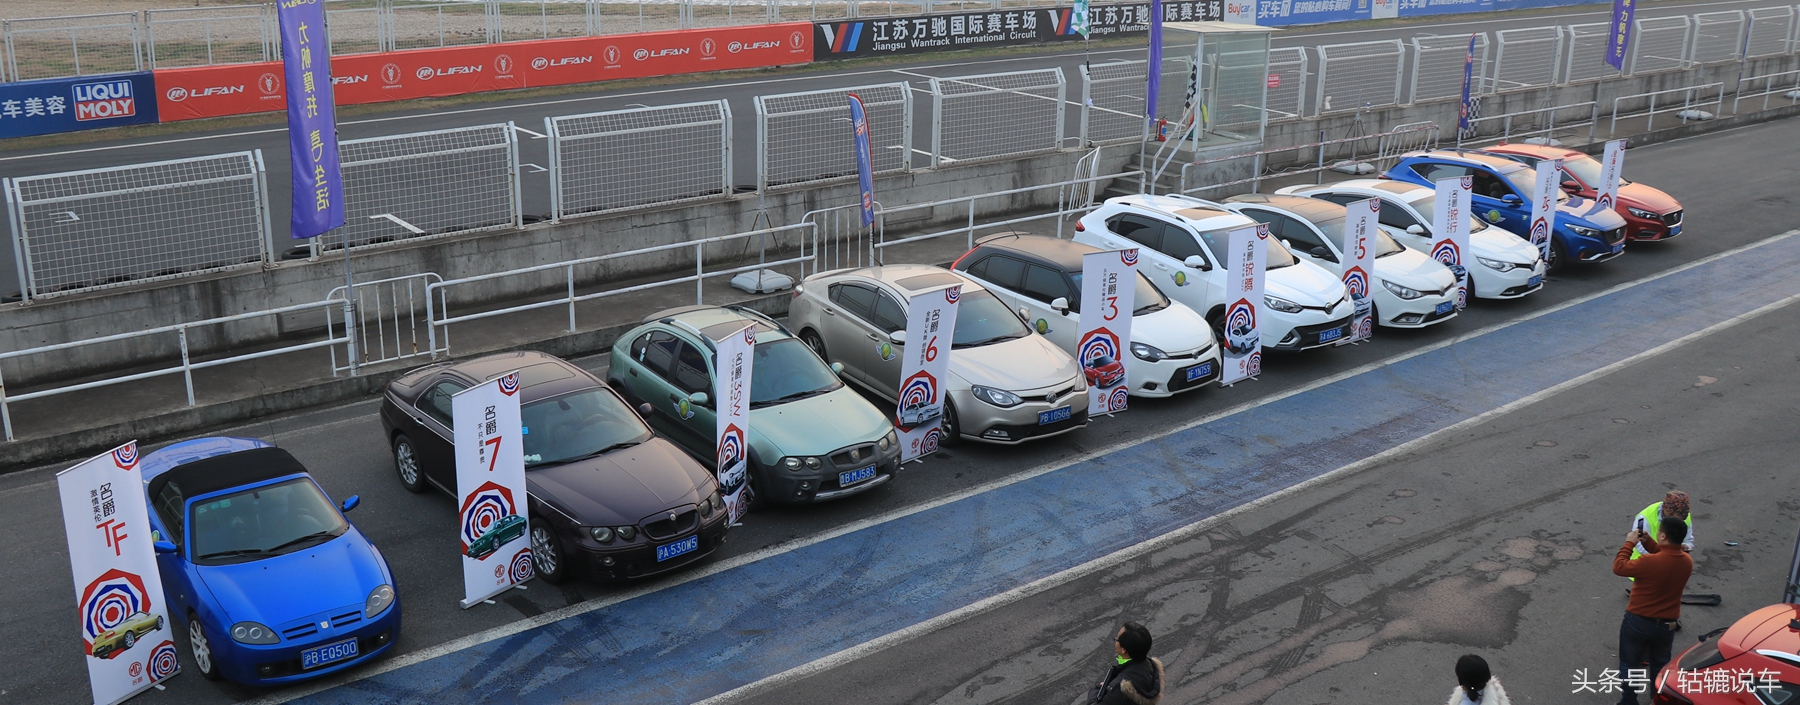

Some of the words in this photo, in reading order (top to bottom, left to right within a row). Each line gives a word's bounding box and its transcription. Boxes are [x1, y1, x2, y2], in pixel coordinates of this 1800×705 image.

[1089, 2, 1221, 26] 江苏万驰际赛车场
[872, 11, 1037, 42] 江苏万驰国际赛车场
[1089, 26, 1116, 35] Jiangsu
[1119, 24, 1149, 32] Wantrac
[650, 47, 690, 58] LIFAN
[744, 40, 780, 50] LIFAN
[872, 41, 906, 51] Jiangsu
[911, 38, 950, 48] Wantrack
[955, 32, 1005, 44] International
[437, 64, 482, 77] LIFAN
[550, 55, 592, 67] LIFAN
[75, 82, 130, 101] LIQUI
[191, 84, 244, 97] LIFAN
[0, 95, 66, 119] 车美容
[78, 99, 132, 119] MOLY
[1357, 237, 1366, 260] 5
[1108, 272, 1117, 295] 名爵
[930, 308, 941, 333] 名爵
[1103, 296, 1118, 321] 3
[925, 335, 938, 362] 6
[734, 352, 743, 380] 名爵
[733, 380, 742, 416] 3SW
[485, 405, 497, 435] 名爵
[485, 435, 502, 472] 7
[90, 489, 102, 523] 激情英伦
[100, 482, 116, 517] 名爵
[96, 518, 128, 557] TF
[129, 662, 142, 676] MG
